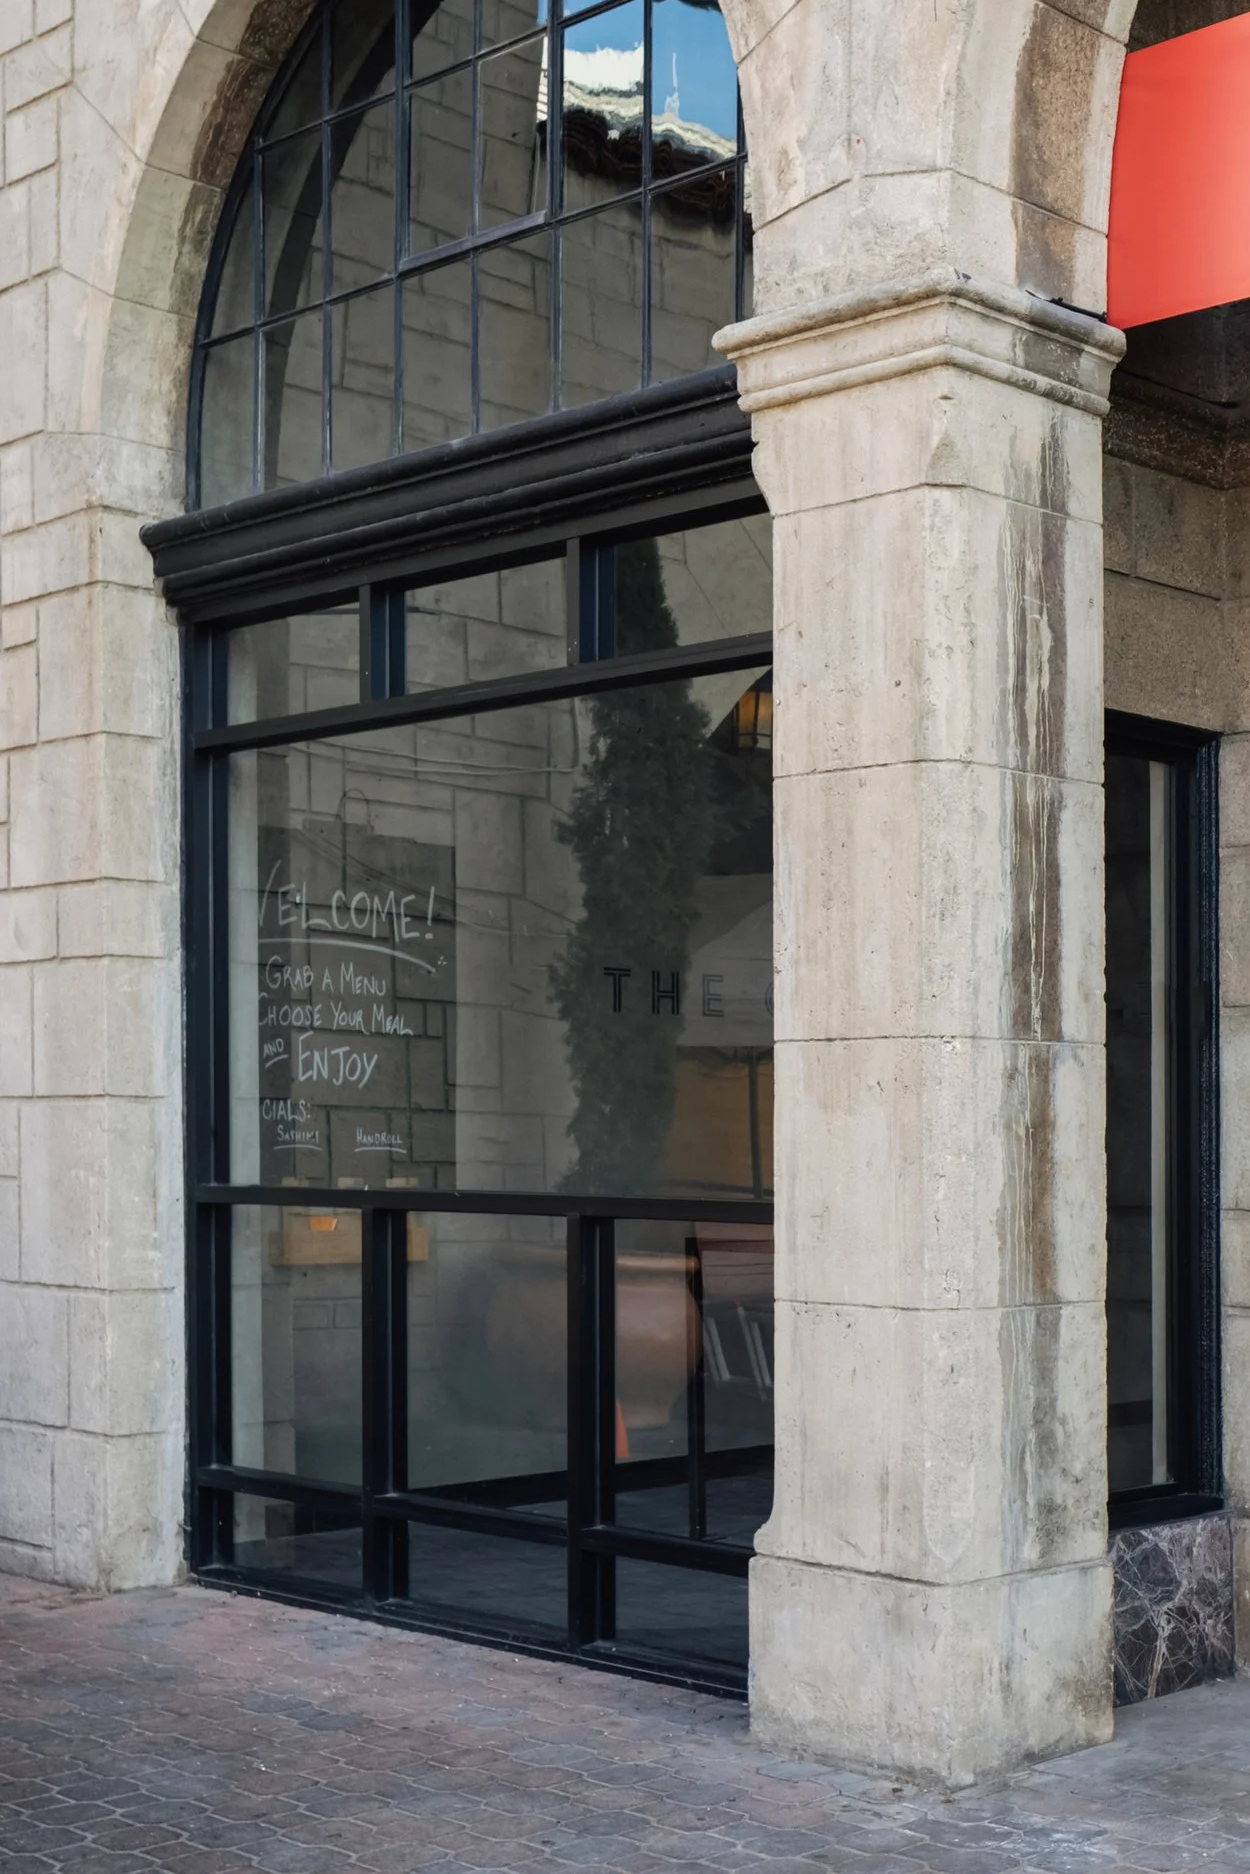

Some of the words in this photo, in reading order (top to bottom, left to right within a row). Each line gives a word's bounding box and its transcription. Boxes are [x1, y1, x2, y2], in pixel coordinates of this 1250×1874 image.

[258, 860, 435, 942] ELCOME!
[265, 955, 315, 992] GRAB
[321, 967, 334, 994] A
[340, 961, 387, 997] MENU
[603, 967, 725, 1017] THE
[330, 1000, 370, 1035] YOUR
[371, 1002, 414, 1036] MEAL
[263, 1038, 285, 1058] AND
[298, 1030, 379, 1089] ENJOY
